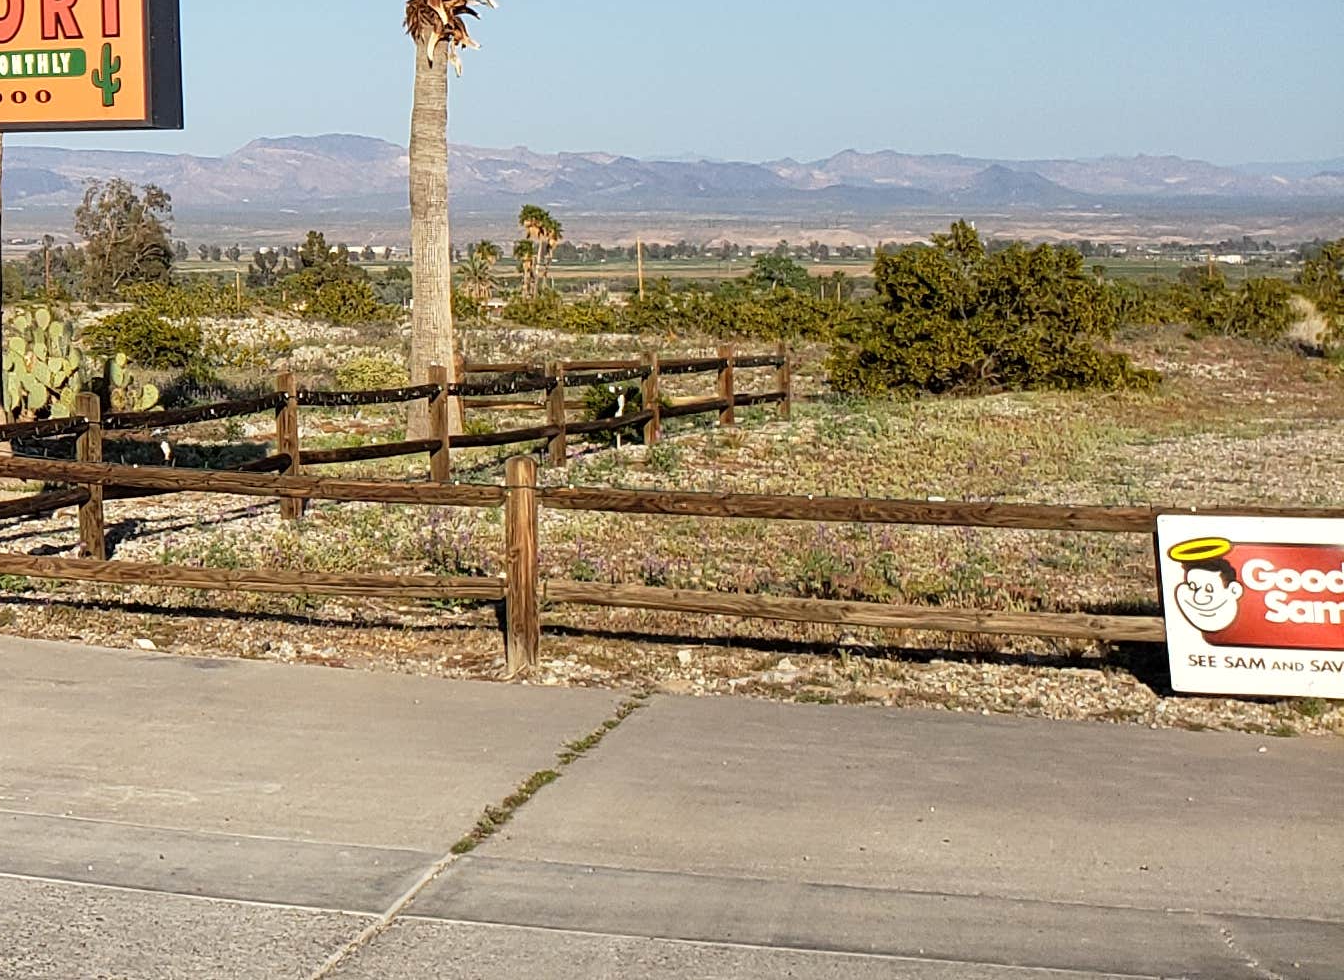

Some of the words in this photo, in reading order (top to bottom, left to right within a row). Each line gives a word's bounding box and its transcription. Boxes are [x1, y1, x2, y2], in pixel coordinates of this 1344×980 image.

[1241, 558, 1344, 593] Good
[1264, 590, 1344, 624] Sam
[1187, 654, 1217, 668] SEE
[1224, 656, 1266, 670] SAM
[1271, 661, 1305, 672] AND
